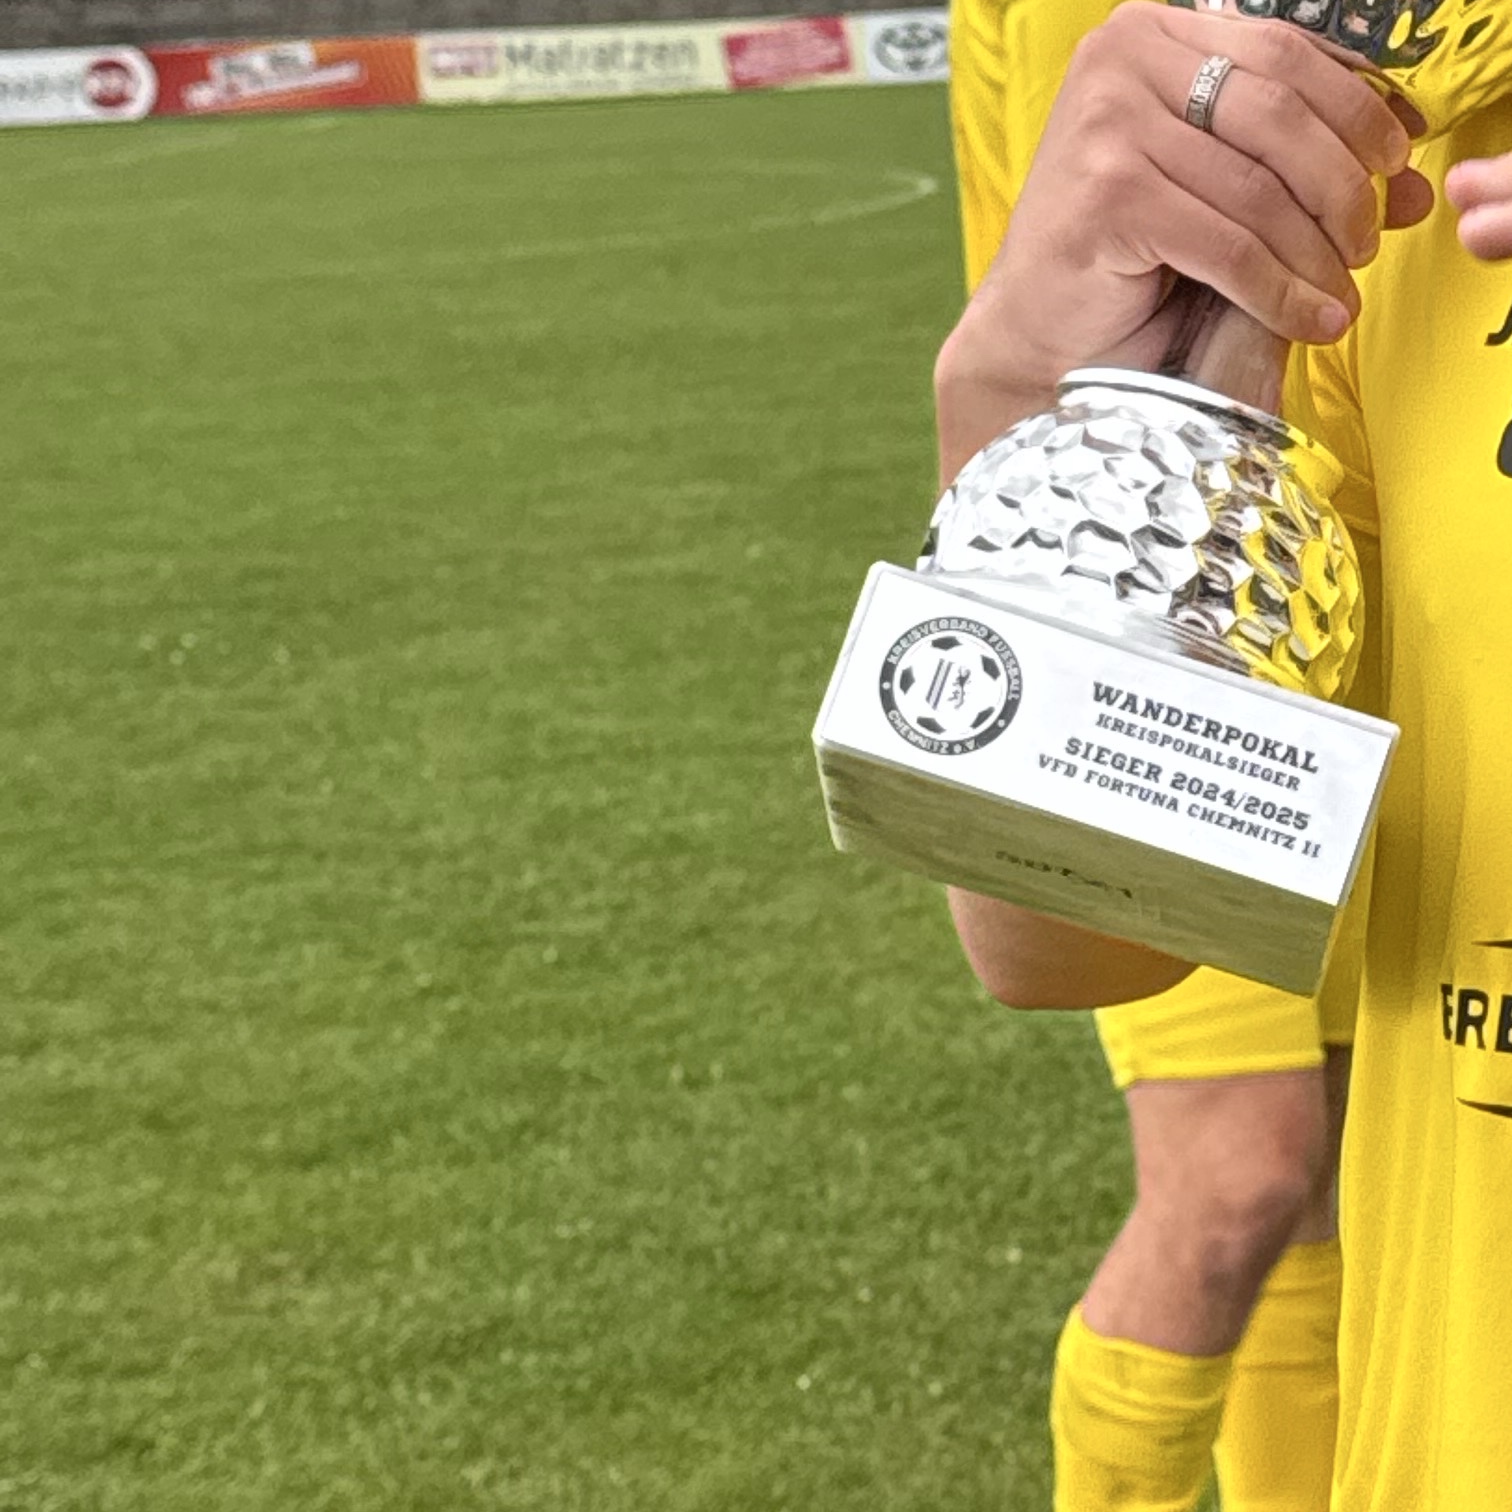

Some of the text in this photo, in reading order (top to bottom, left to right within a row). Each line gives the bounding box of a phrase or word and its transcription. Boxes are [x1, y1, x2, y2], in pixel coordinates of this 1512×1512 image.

[1093, 681, 1318, 774] WANDERPOKAL
[1095, 713, 1301, 791] KREISPOKALSIEGER
[1065, 737, 1311, 831] SIEGER 2024/2025
[1084, 769, 1179, 813] FORTUNA
[1187, 803, 1297, 850] CHEMNITZ
